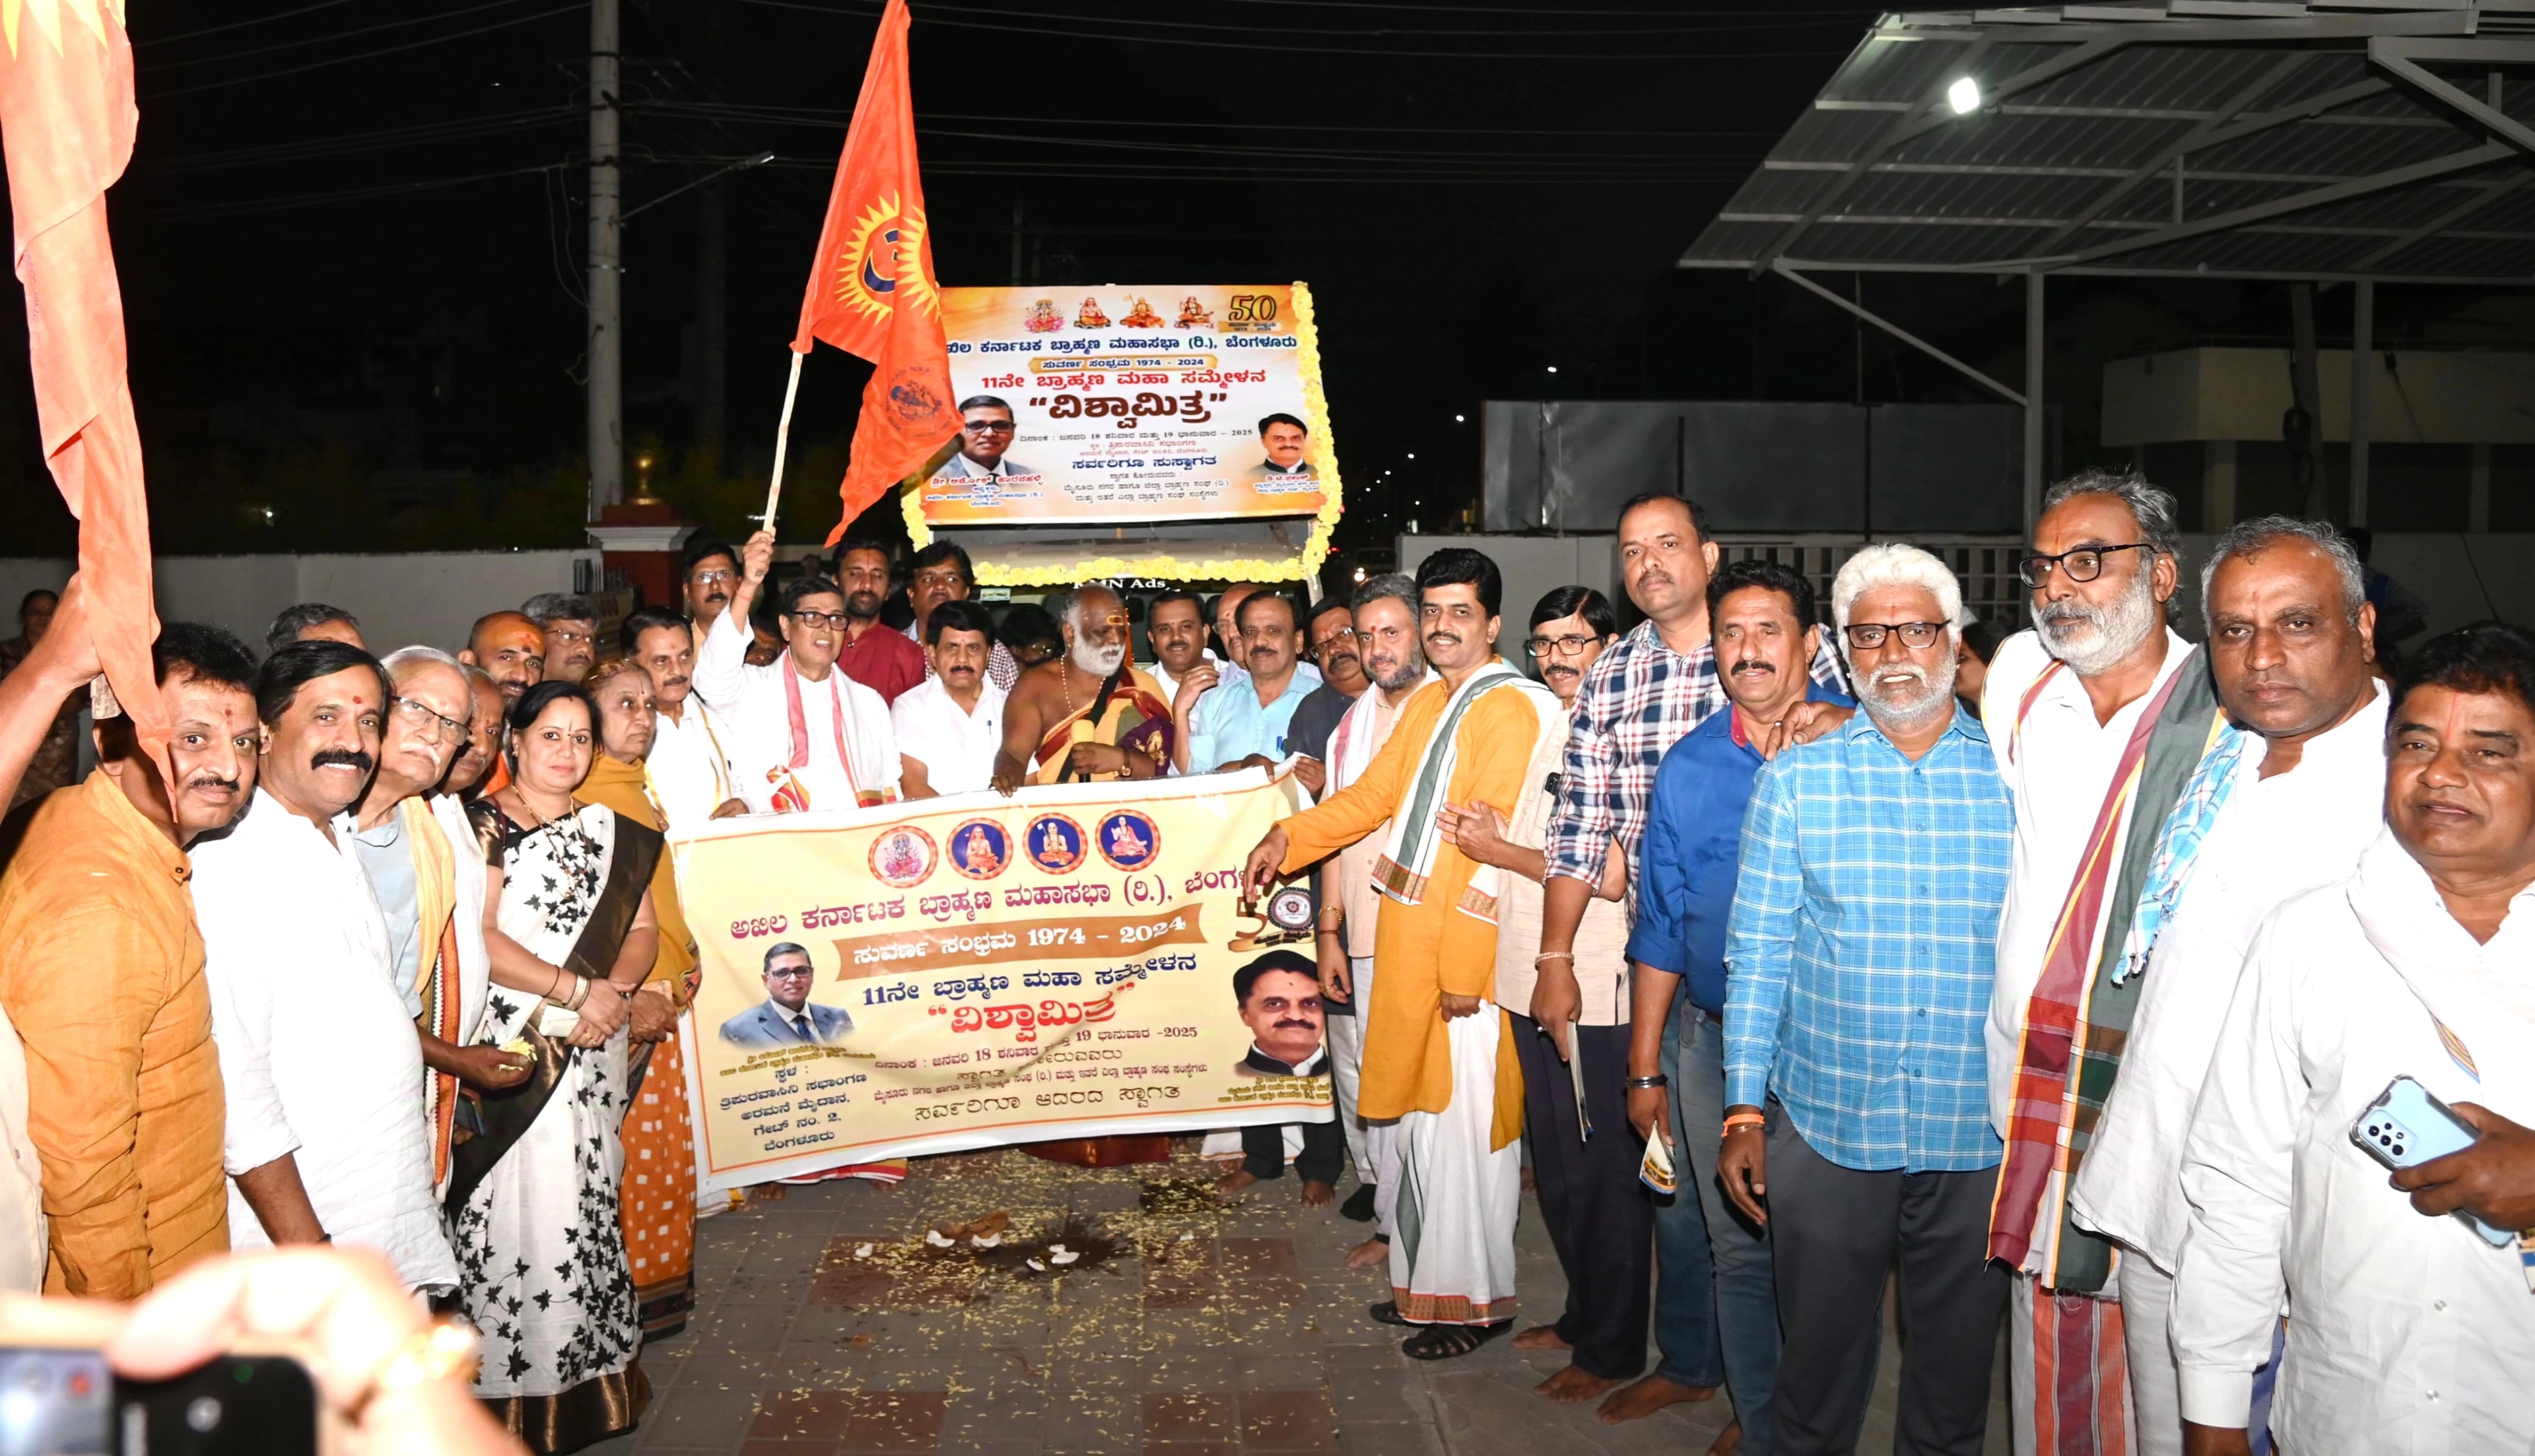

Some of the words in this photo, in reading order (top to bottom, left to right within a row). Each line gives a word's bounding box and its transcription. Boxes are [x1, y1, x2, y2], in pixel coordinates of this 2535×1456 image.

[1229, 295, 1276, 321] 50
[946, 341, 972, 353] ಖಿಲ
[980, 340, 1042, 352] ಕರ್ನಾಟಕ
[1050, 338, 1100, 355] ಬ್ರಾಹ್ಮಣ
[1109, 337, 1180, 350] ಮಹಾಸಭಾ
[1188, 336, 1218, 349] (ರಿ.),
[1226, 335, 1297, 348] ಬೆಂಗಳೂರು
[1042, 360, 1083, 369] ಸುವರ್ಣ
[1089, 359, 1130, 369] ಸಂಭ್ರಮ
[982, 374, 1025, 388] 11ನೇ
[1037, 372, 1104, 391] ಬ್ರಾಹ್ಮಣ
[1117, 371, 1168, 385] ಮಹಾ
[1181, 369, 1266, 388] ಸಮ್ಮೇಳನ
[1072, 458, 1145, 469] ಸರ್ವರಿಗೂ
[1153, 455, 1217, 471] ಸುಸ್ವಾಗತ
[1130, 578, 1166, 588] Ads
[731, 912, 788, 939] ಅಖಿಲ
[801, 894, 906, 929] ಕರ್ನಾಟಕ
[920, 886, 992, 922] ಬ್ರಾಹ್ಮಣ
[1004, 879, 1110, 907] ಮಹಾಸಭಾ
[1124, 874, 1172, 907] (ರಿ.),
[1185, 864, 1266, 894] ಬೆಂಗ
[854, 941, 929, 965] ಸುವರ್ಣ
[941, 931, 1016, 956] ಸಂಭ್ರಮ
[1027, 927, 1085, 946] 1974
[1120, 915, 1186, 944] 2024
[863, 981, 920, 1005] 11ನೇ
[933, 972, 1009, 1001] ಬ್ರಾಹ್ಮಣ
[1023, 968, 1082, 987] ಮಹಾ
[1095, 952, 1197, 986] ಸಮ್ಮೇಳನ
[875, 1059, 917, 1069] ದಿನಾಂಕ
[932, 1053, 969, 1067] ಜನವರಿ
[976, 1047, 991, 1062] 18
[997, 1045, 1038, 1059] ಶನಿವಾರ
[1076, 1030, 1091, 1042] 19
[1098, 1027, 1151, 1042] ಭಾನುವಾರ
[775, 1066, 797, 1083] ಸ್ಥಳ
[720, 1083, 798, 1110] ತ್ರಿಪುರವಾಸಿನಿ
[806, 1073, 867, 1091] ಸಭಾಂಗಣ
[874, 1088, 908, 1104] ಮೈಸೂರು
[741, 1102, 790, 1120] ಅರಮನೆ
[915, 1095, 1021, 1121] ಸರ್ವರಿಗೂ
[1036, 1089, 1103, 1106] ಆದರದ
[1119, 1085, 1180, 1108] ಸ್ವಾಗತ
[754, 1119, 790, 1136] ಗೇಟ್
[796, 1117, 820, 1129] ನಂ.
[764, 1131, 835, 1151] ಬೆಂಗಳೂರು
